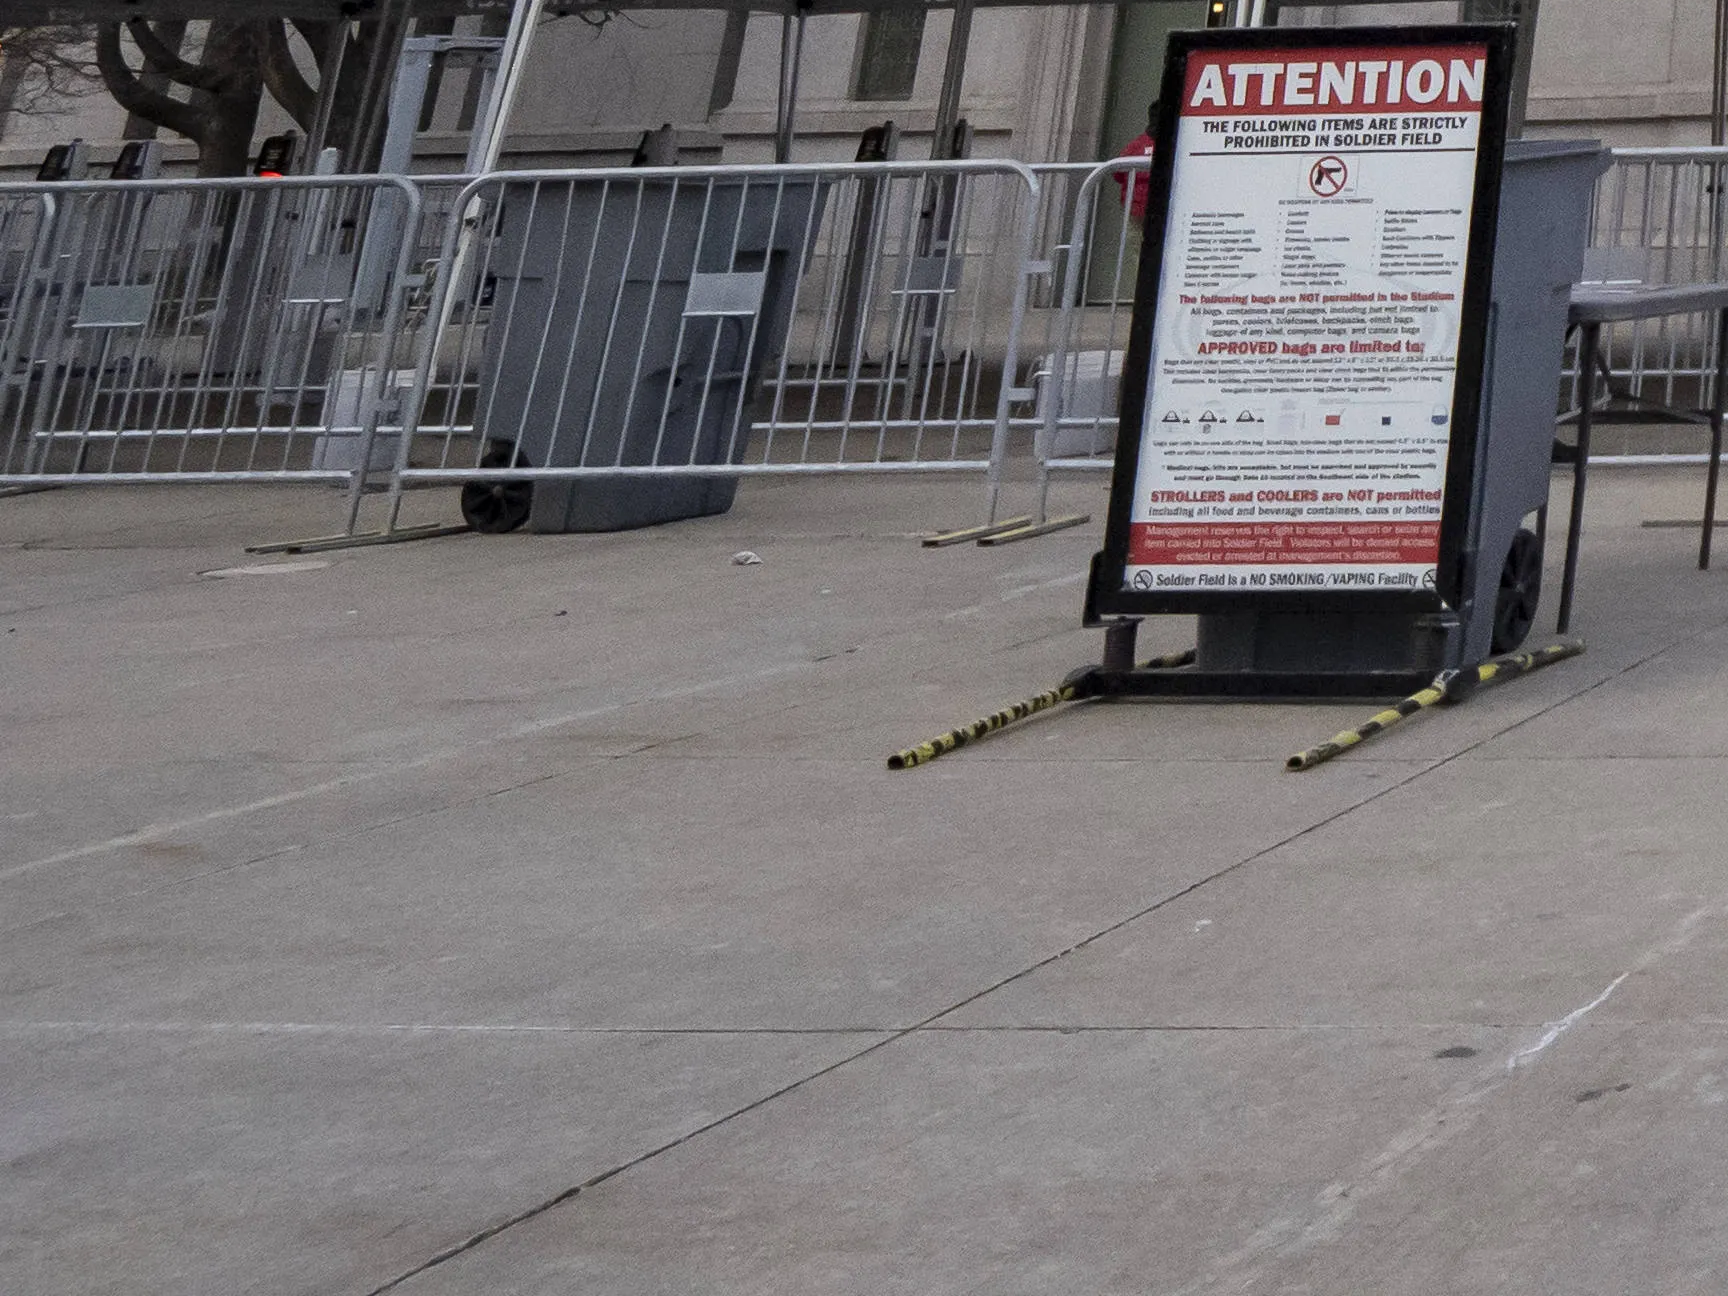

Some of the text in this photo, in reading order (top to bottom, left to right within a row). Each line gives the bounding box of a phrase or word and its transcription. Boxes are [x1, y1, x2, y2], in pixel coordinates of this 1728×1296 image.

[1190, 59, 1486, 107] ATTENTION
[1202, 117, 1468, 133] THE FOLLOWING ITEMS ARE STRICTLY
[1224, 133, 1442, 149] PROHIBITED IN SOLDIER FIELD
[1179, 292, 1454, 306] The following bags are NOT permitted in the Stadium
[1270, 307, 1286, 315] and
[1197, 340, 1401, 357] APPROVED bags are limited
[1151, 488, 1442, 503] STROLLERS and COOLERS are NOT permitted
[1149, 507, 1194, 517] including
[1197, 507, 1210, 516] all
[1213, 506, 1234, 515] food
[1237, 506, 1255, 515] and
[1258, 506, 1303, 517] beverage
[1366, 506, 1389, 514] cans
[1392, 506, 1402, 514] or
[1405, 505, 1440, 514] bottles
[1146, 525, 1210, 536] Management
[1156, 573, 1418, 586] Soldier Field is a NO SMOKING/VAPING Facility
